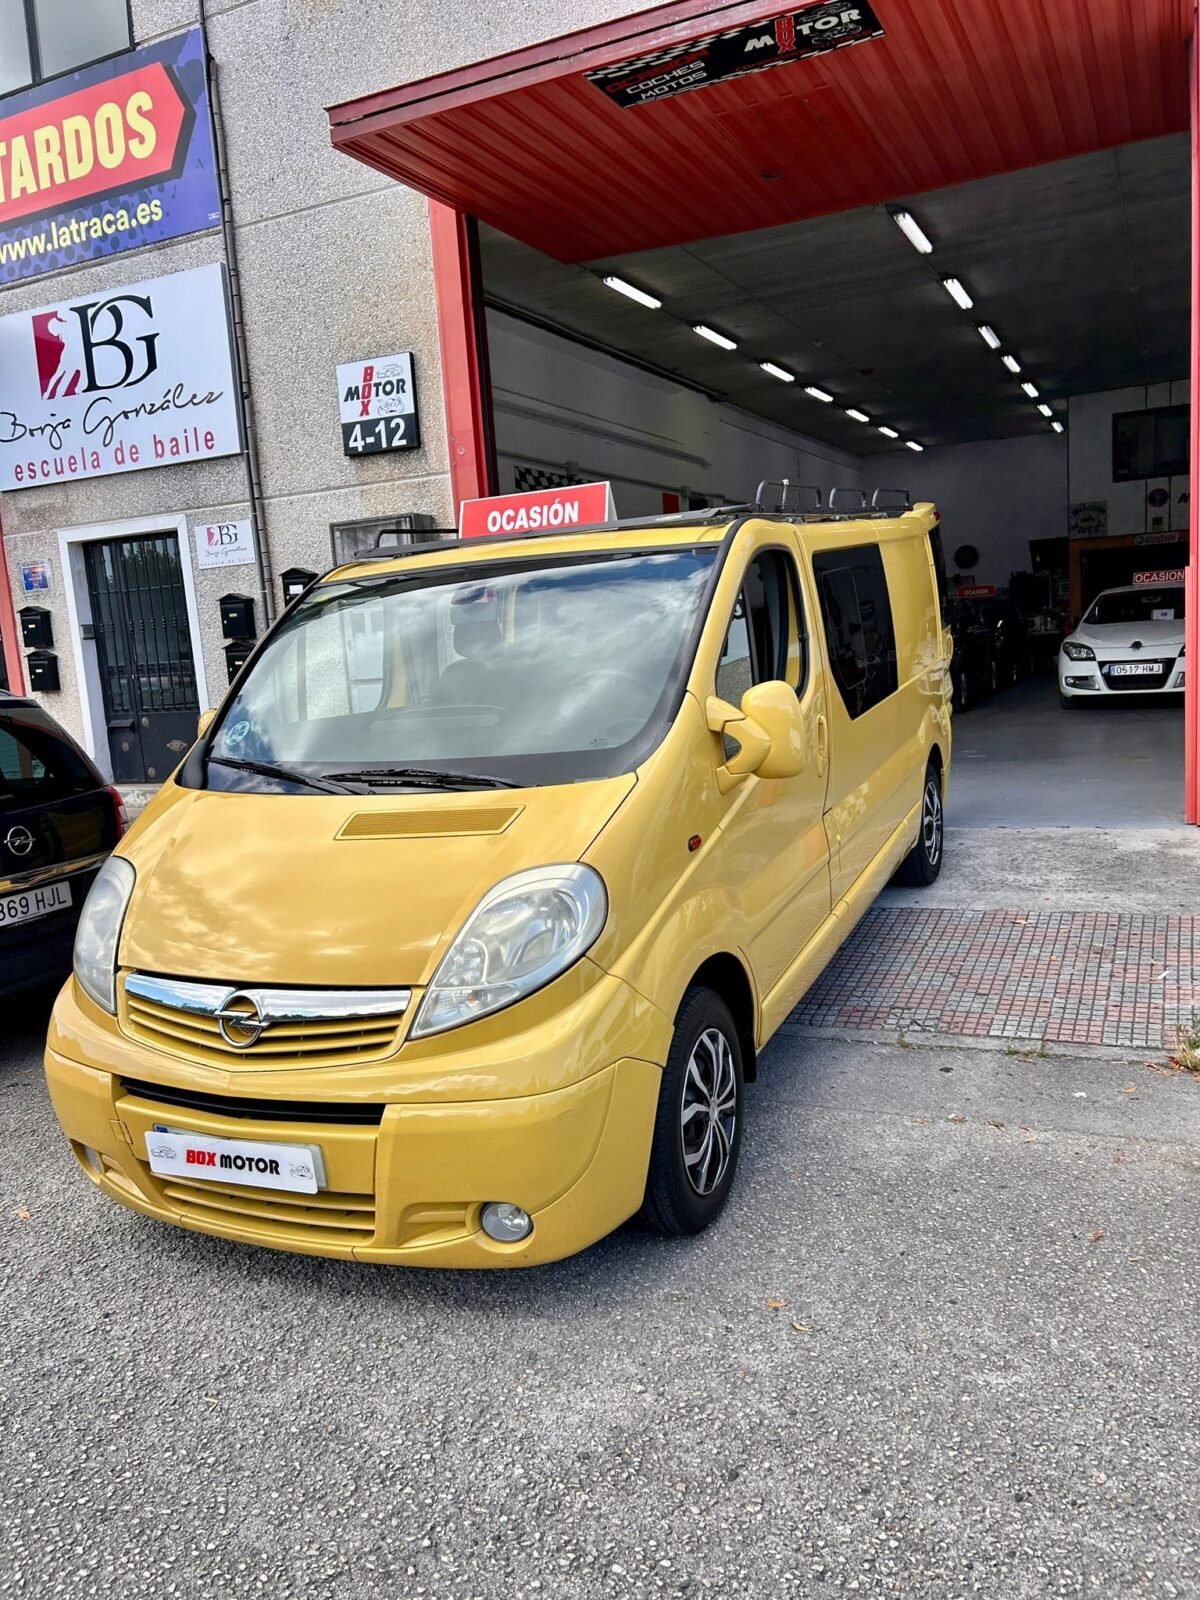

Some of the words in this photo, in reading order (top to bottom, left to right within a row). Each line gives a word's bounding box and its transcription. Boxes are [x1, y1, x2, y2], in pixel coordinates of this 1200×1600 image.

[626, 60, 706, 94] COCHES
[641, 70, 708, 100] MOTOS
[359, 365, 374, 417] BOX
[0, 411, 71, 450] Borja
[83, 383, 224, 448] González
[348, 417, 407, 452] 4-12
[15, 447, 101, 482] escuela
[114, 440, 140, 465] de
[153, 427, 215, 460] baile
[487, 498, 580, 533] OCASIÓN
[35, 887, 66, 911] HJL
[186, 1149, 216, 1167] BOX
[220, 1153, 280, 1176] MOTOR
